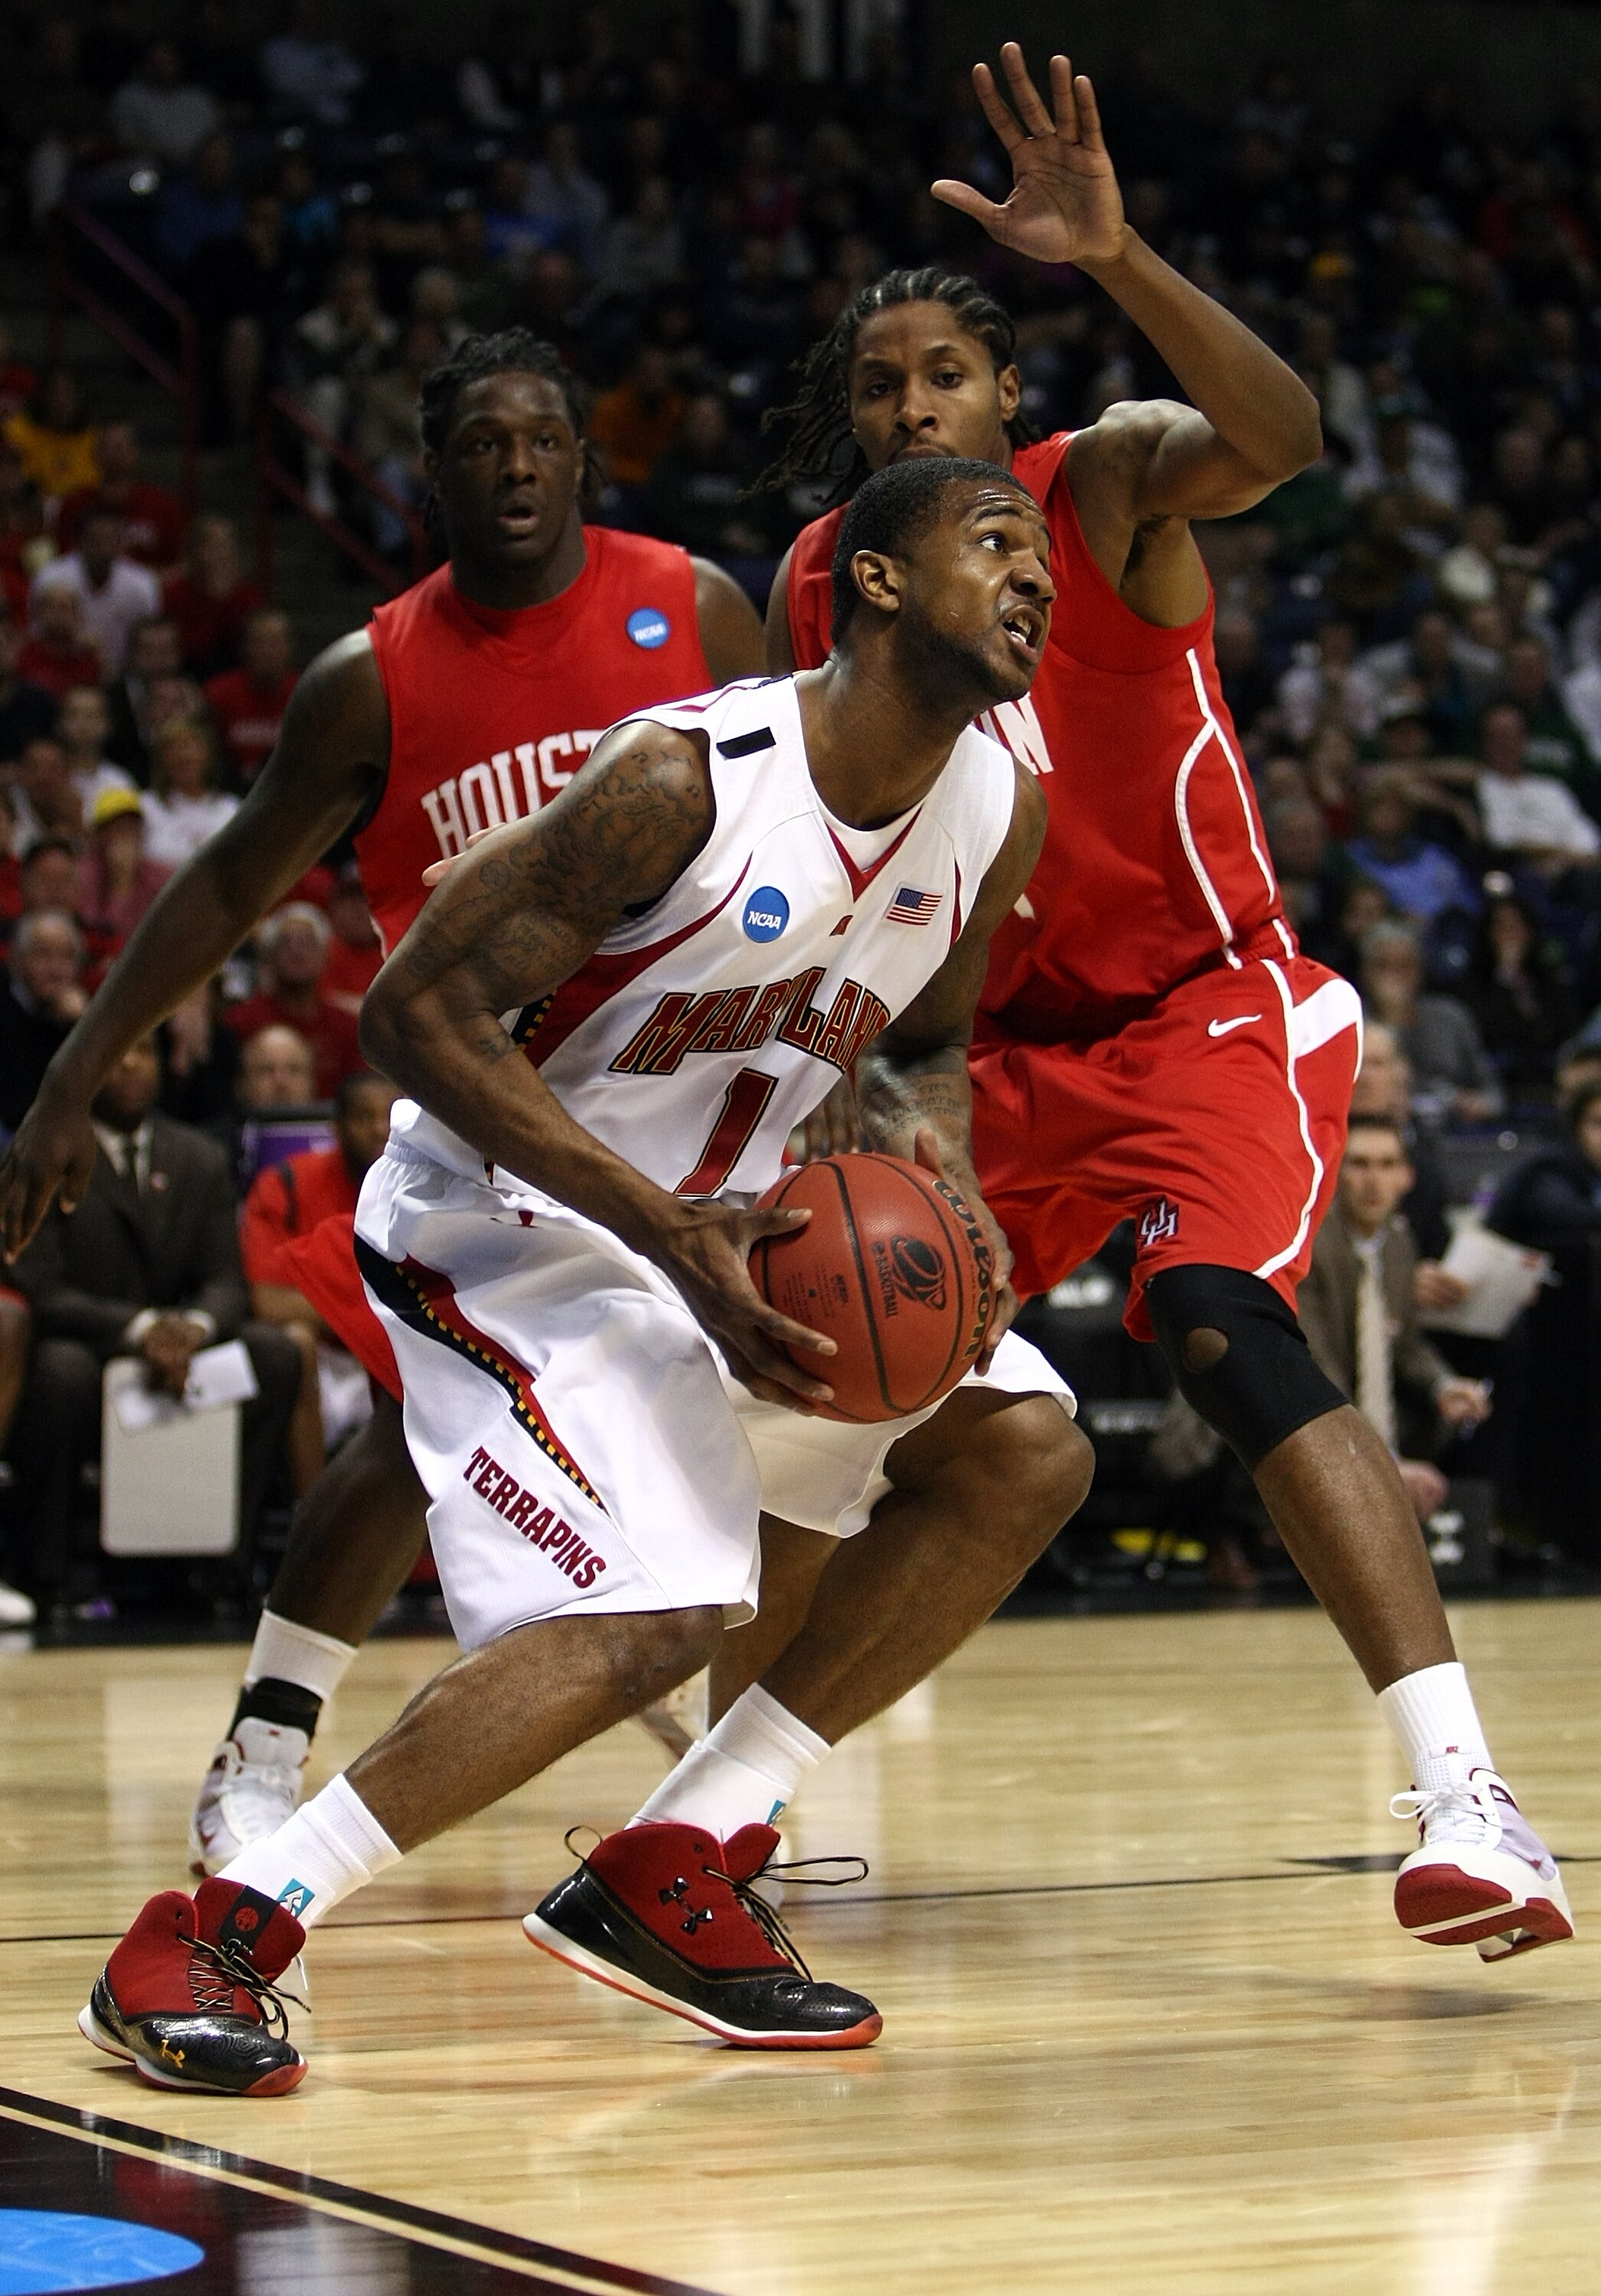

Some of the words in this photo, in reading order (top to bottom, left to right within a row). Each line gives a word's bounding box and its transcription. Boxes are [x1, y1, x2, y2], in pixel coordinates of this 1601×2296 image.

[748, 911, 781, 931] NCAA
[673, 1068, 779, 1199] 1
[876, 1255, 898, 1319] BASKETBALL
[463, 1446, 607, 1589] TERRAPINS
